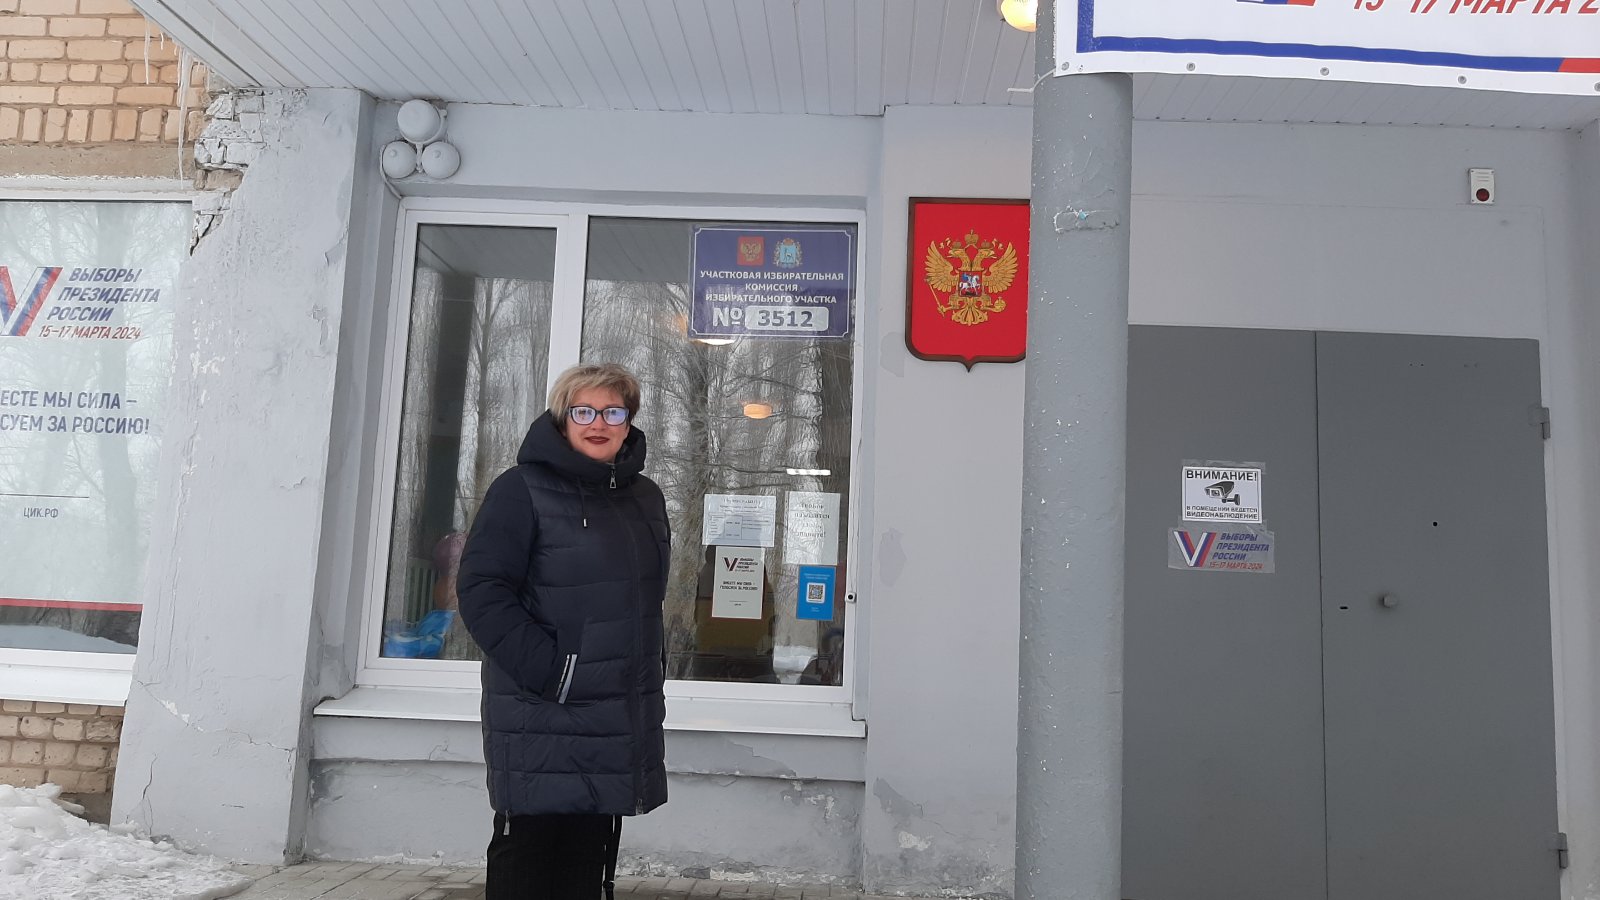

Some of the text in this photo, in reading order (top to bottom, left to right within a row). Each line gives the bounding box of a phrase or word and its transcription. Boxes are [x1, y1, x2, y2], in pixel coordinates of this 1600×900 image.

[69, 267, 142, 282] ВЫБОРЫ
[700, 270, 844, 281] УЧАСТКОВАЯ ИЗБИРАТЕЛЬНАЯ
[745, 283, 798, 292] КОМИССИЯ
[58, 287, 160, 304] ПРЕЗИДЕНТА
[705, 294, 837, 304] ИЗБИРАТЕЛЬНОГО УЧАСТКА
[47, 306, 114, 321] РОССИИ
[712, 307, 813, 328] № 3512
[71, 326, 111, 339] МАРТА
[111, 326, 141, 340] 2024
[42, 391, 73, 408] МЫ
[77, 392, 121, 410] СИЛА
[0, 414, 150, 434] СУЕМ ЗА РОССИЮ!
[1186, 470, 1257, 481] ВНИМАНИЕ!
[23, 507, 59, 519] ЦИК.РФ
[1186, 511, 1258, 519] ВИДЕОНАБЛЮДЕНИЕ
[1216, 543, 1270, 552] ПРЕЗИДЕНТА
[1212, 552, 1246, 560] РОССИИ
